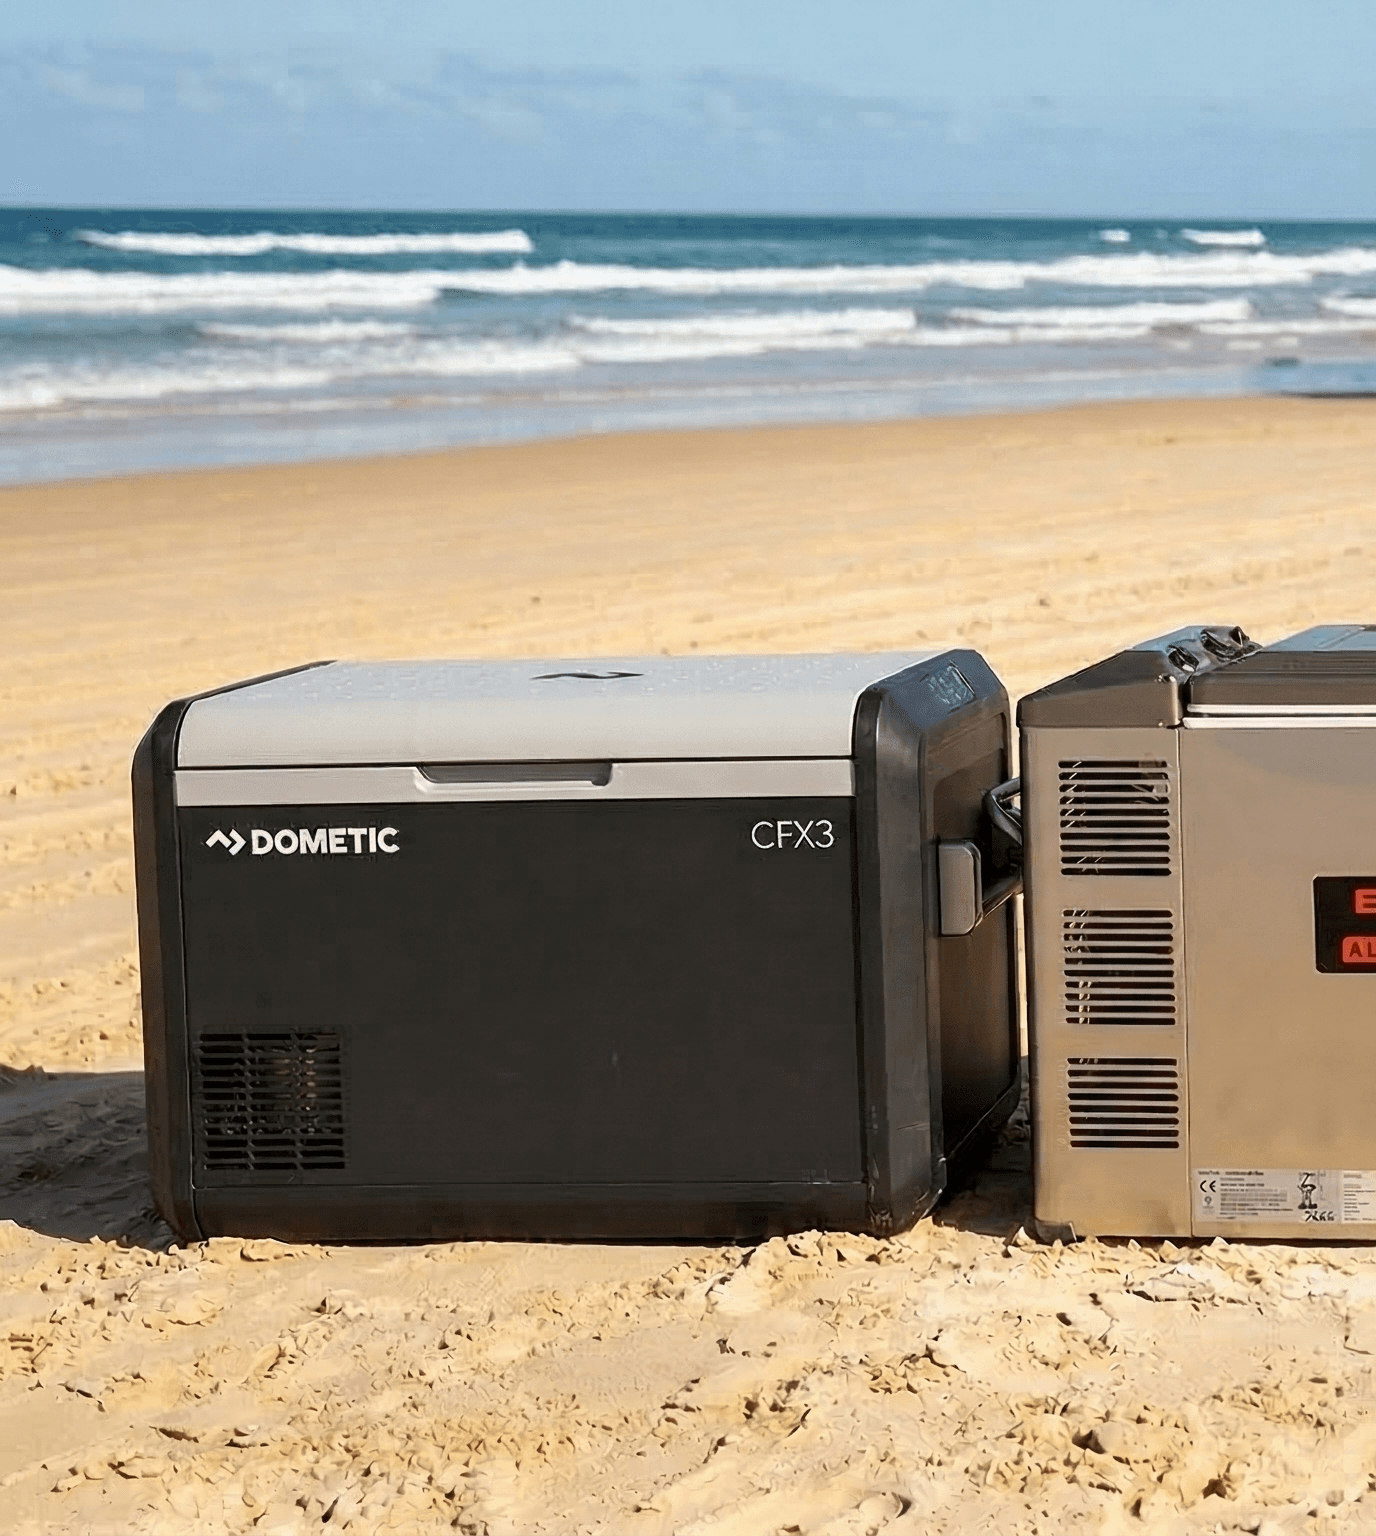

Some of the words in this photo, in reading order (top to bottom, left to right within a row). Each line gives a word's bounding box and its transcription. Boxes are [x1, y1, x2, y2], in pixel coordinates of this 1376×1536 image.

[251, 827, 400, 855] DOMETIC
[751, 819, 835, 849] CFX3
[1350, 941, 1363, 957] A
